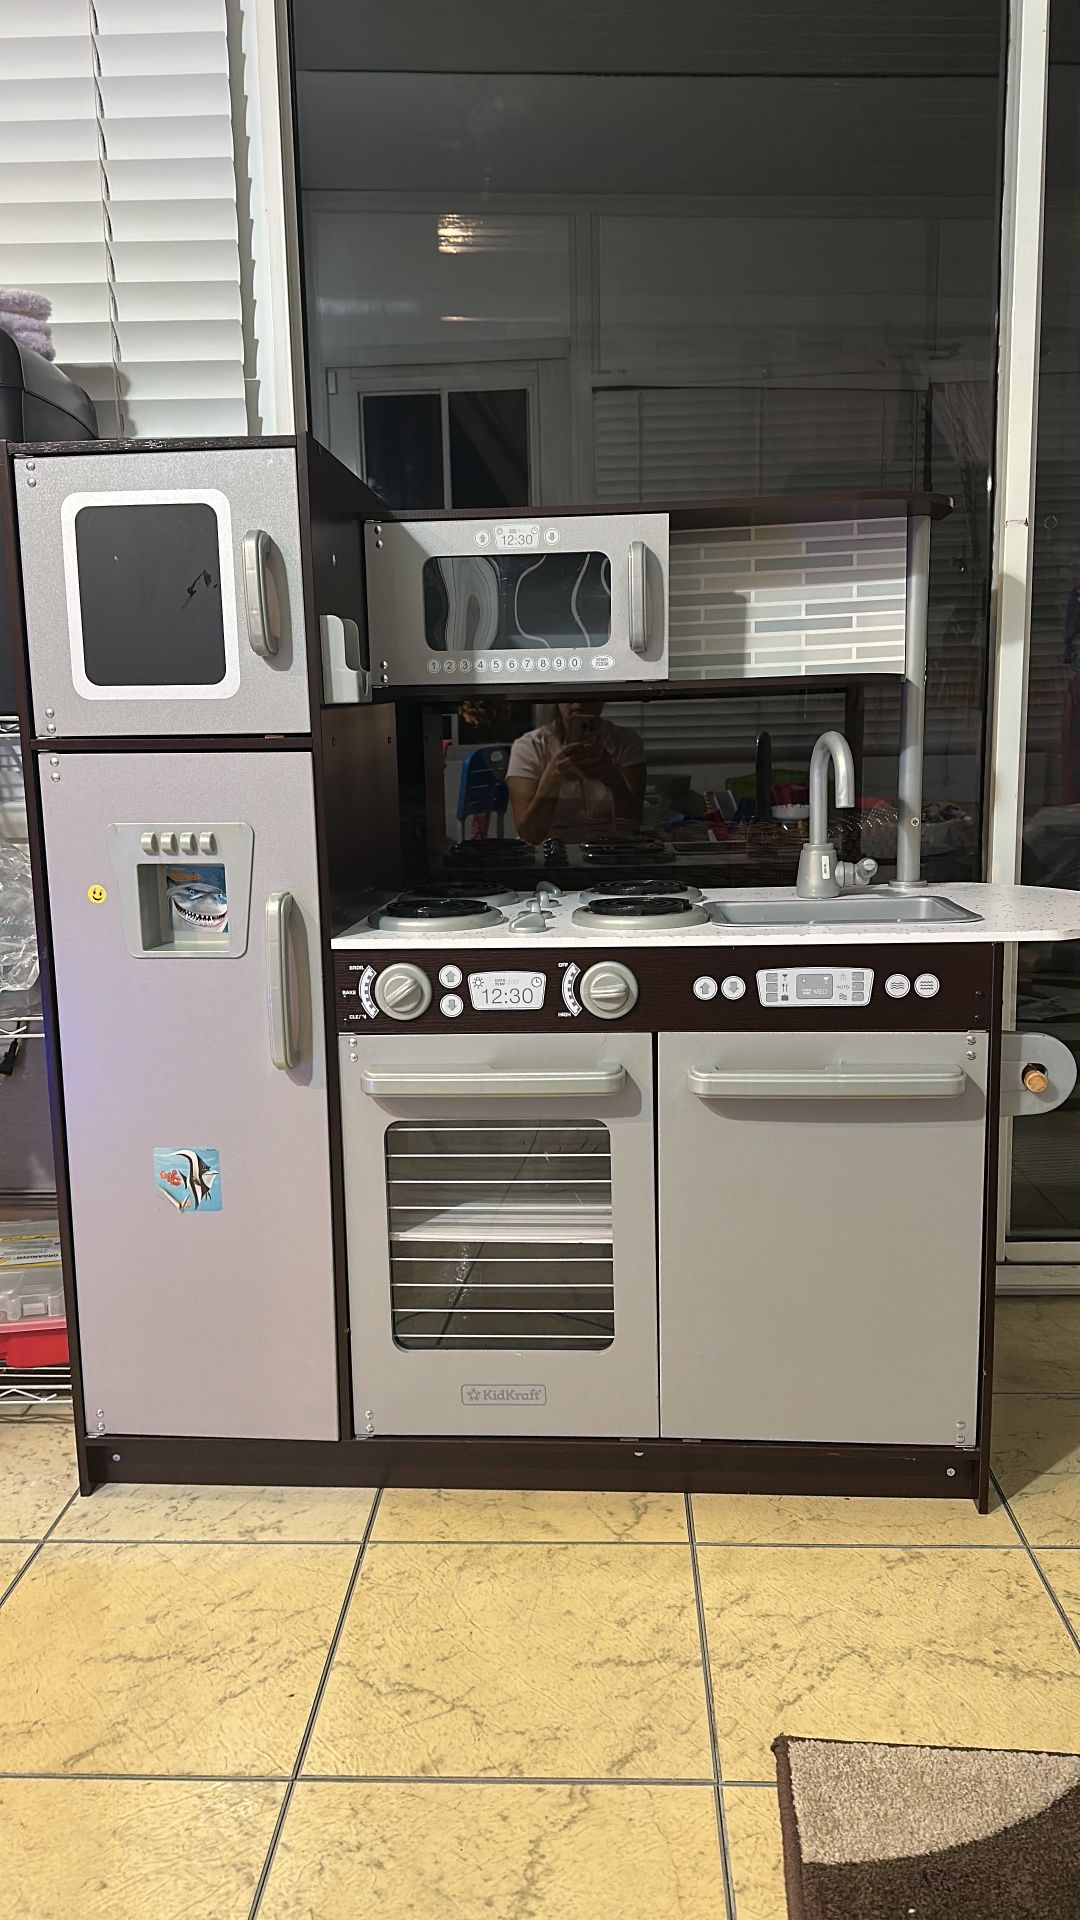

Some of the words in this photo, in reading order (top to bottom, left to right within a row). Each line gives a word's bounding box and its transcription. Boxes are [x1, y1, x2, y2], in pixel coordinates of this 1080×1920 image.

[502, 534, 533, 546] 12:30
[431, 661, 436, 670] 1
[446, 661, 453, 670] 2
[462, 660, 468, 670] 3
[477, 660, 483, 669] 4
[493, 660, 500, 669] 5
[509, 660, 515, 669] 6
[524, 659, 531, 668] 7
[540, 659, 546, 668] 8
[556, 658, 562, 667] 9
[572, 658, 578, 667] 0
[481, 987, 534, 1004] 12:30
[482, 1388, 540, 1401] KidKraft
